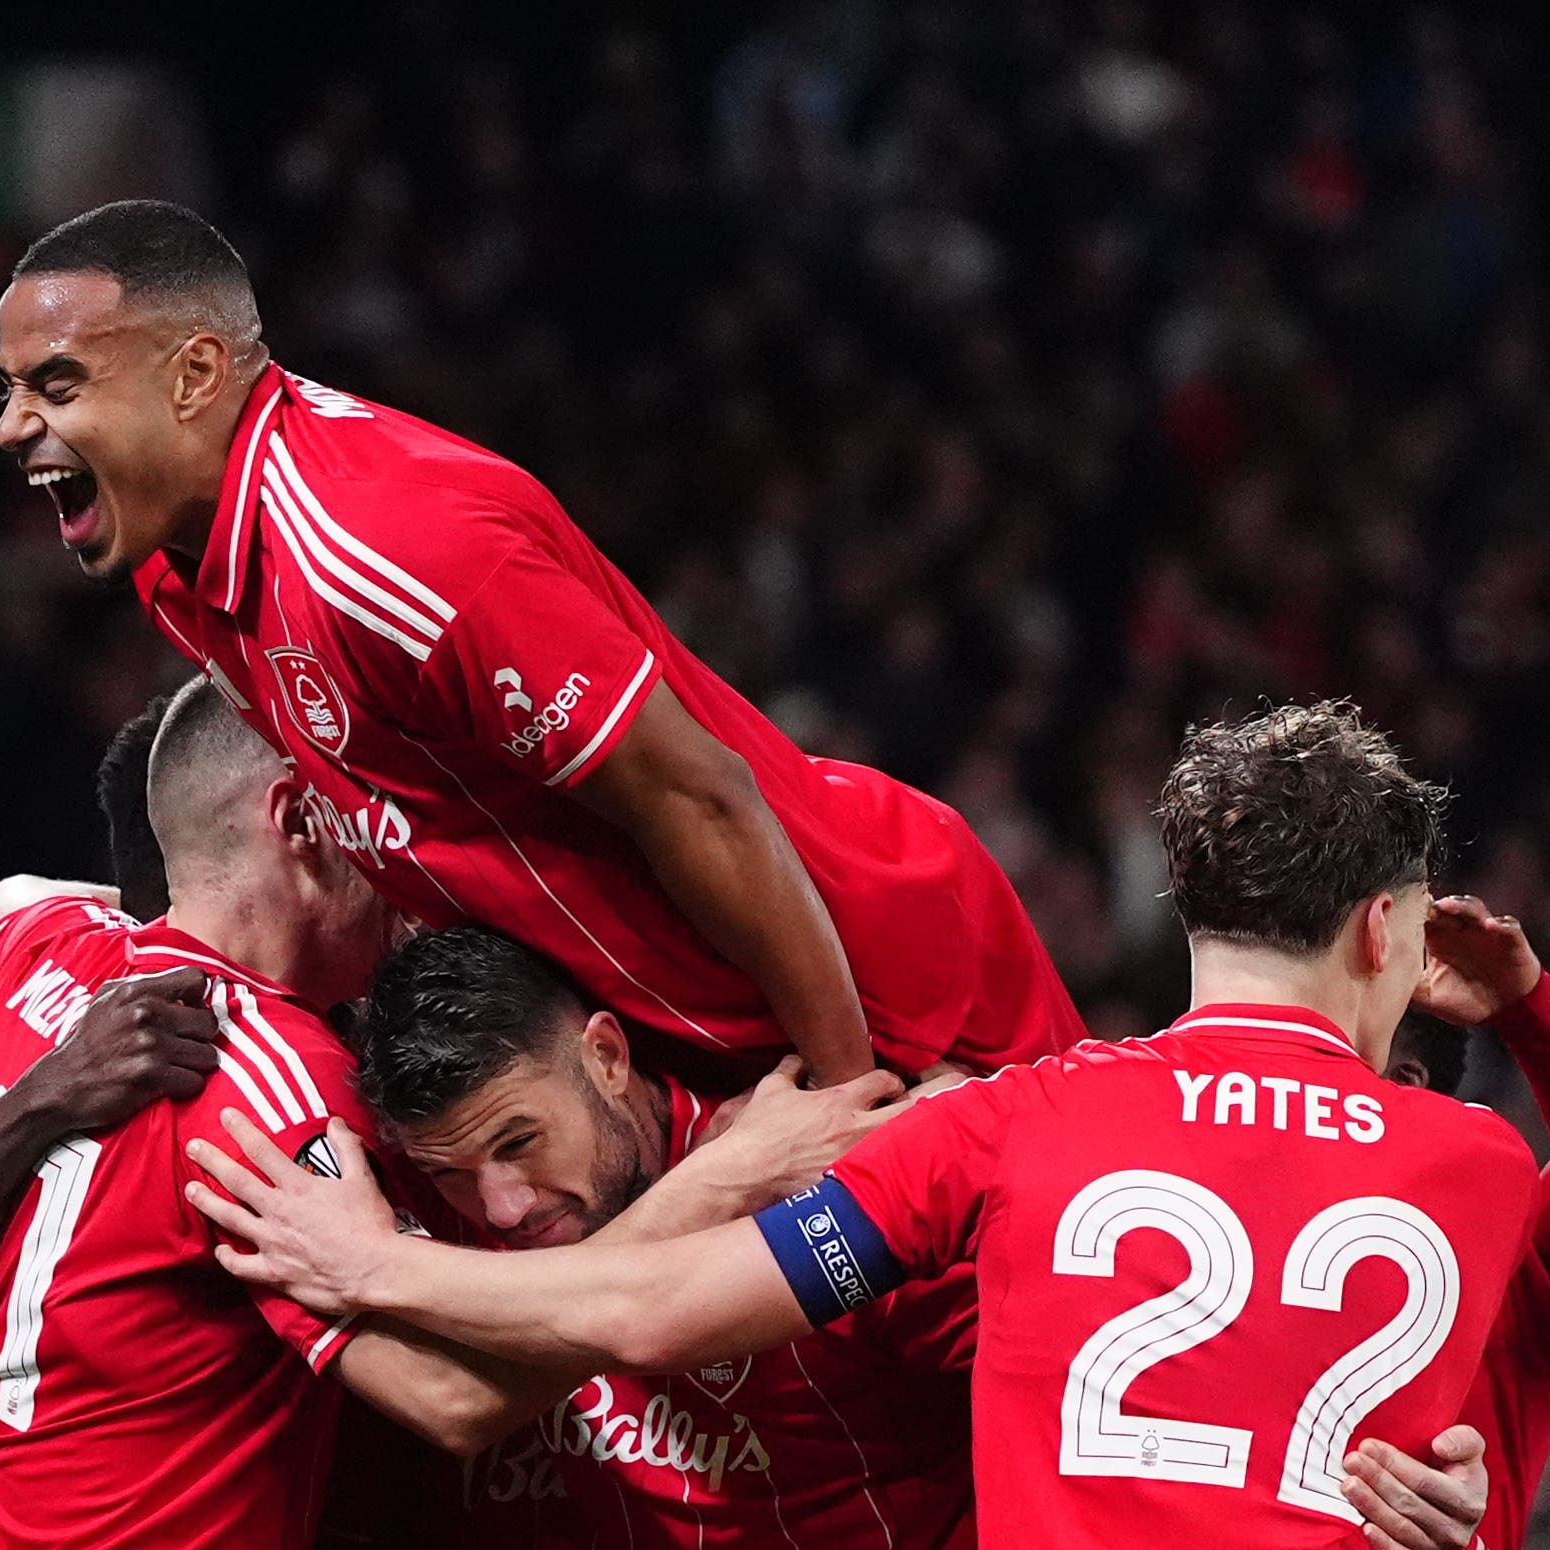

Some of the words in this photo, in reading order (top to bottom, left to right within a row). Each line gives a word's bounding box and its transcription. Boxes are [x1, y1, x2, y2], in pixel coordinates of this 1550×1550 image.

[500, 671, 592, 759] Ideagen
[1171, 1068, 1386, 1144] YATES
[819, 1239, 870, 1308] RESPEC
[1052, 1168, 1461, 1528] 22
[540, 1374, 771, 1493] Bally's
